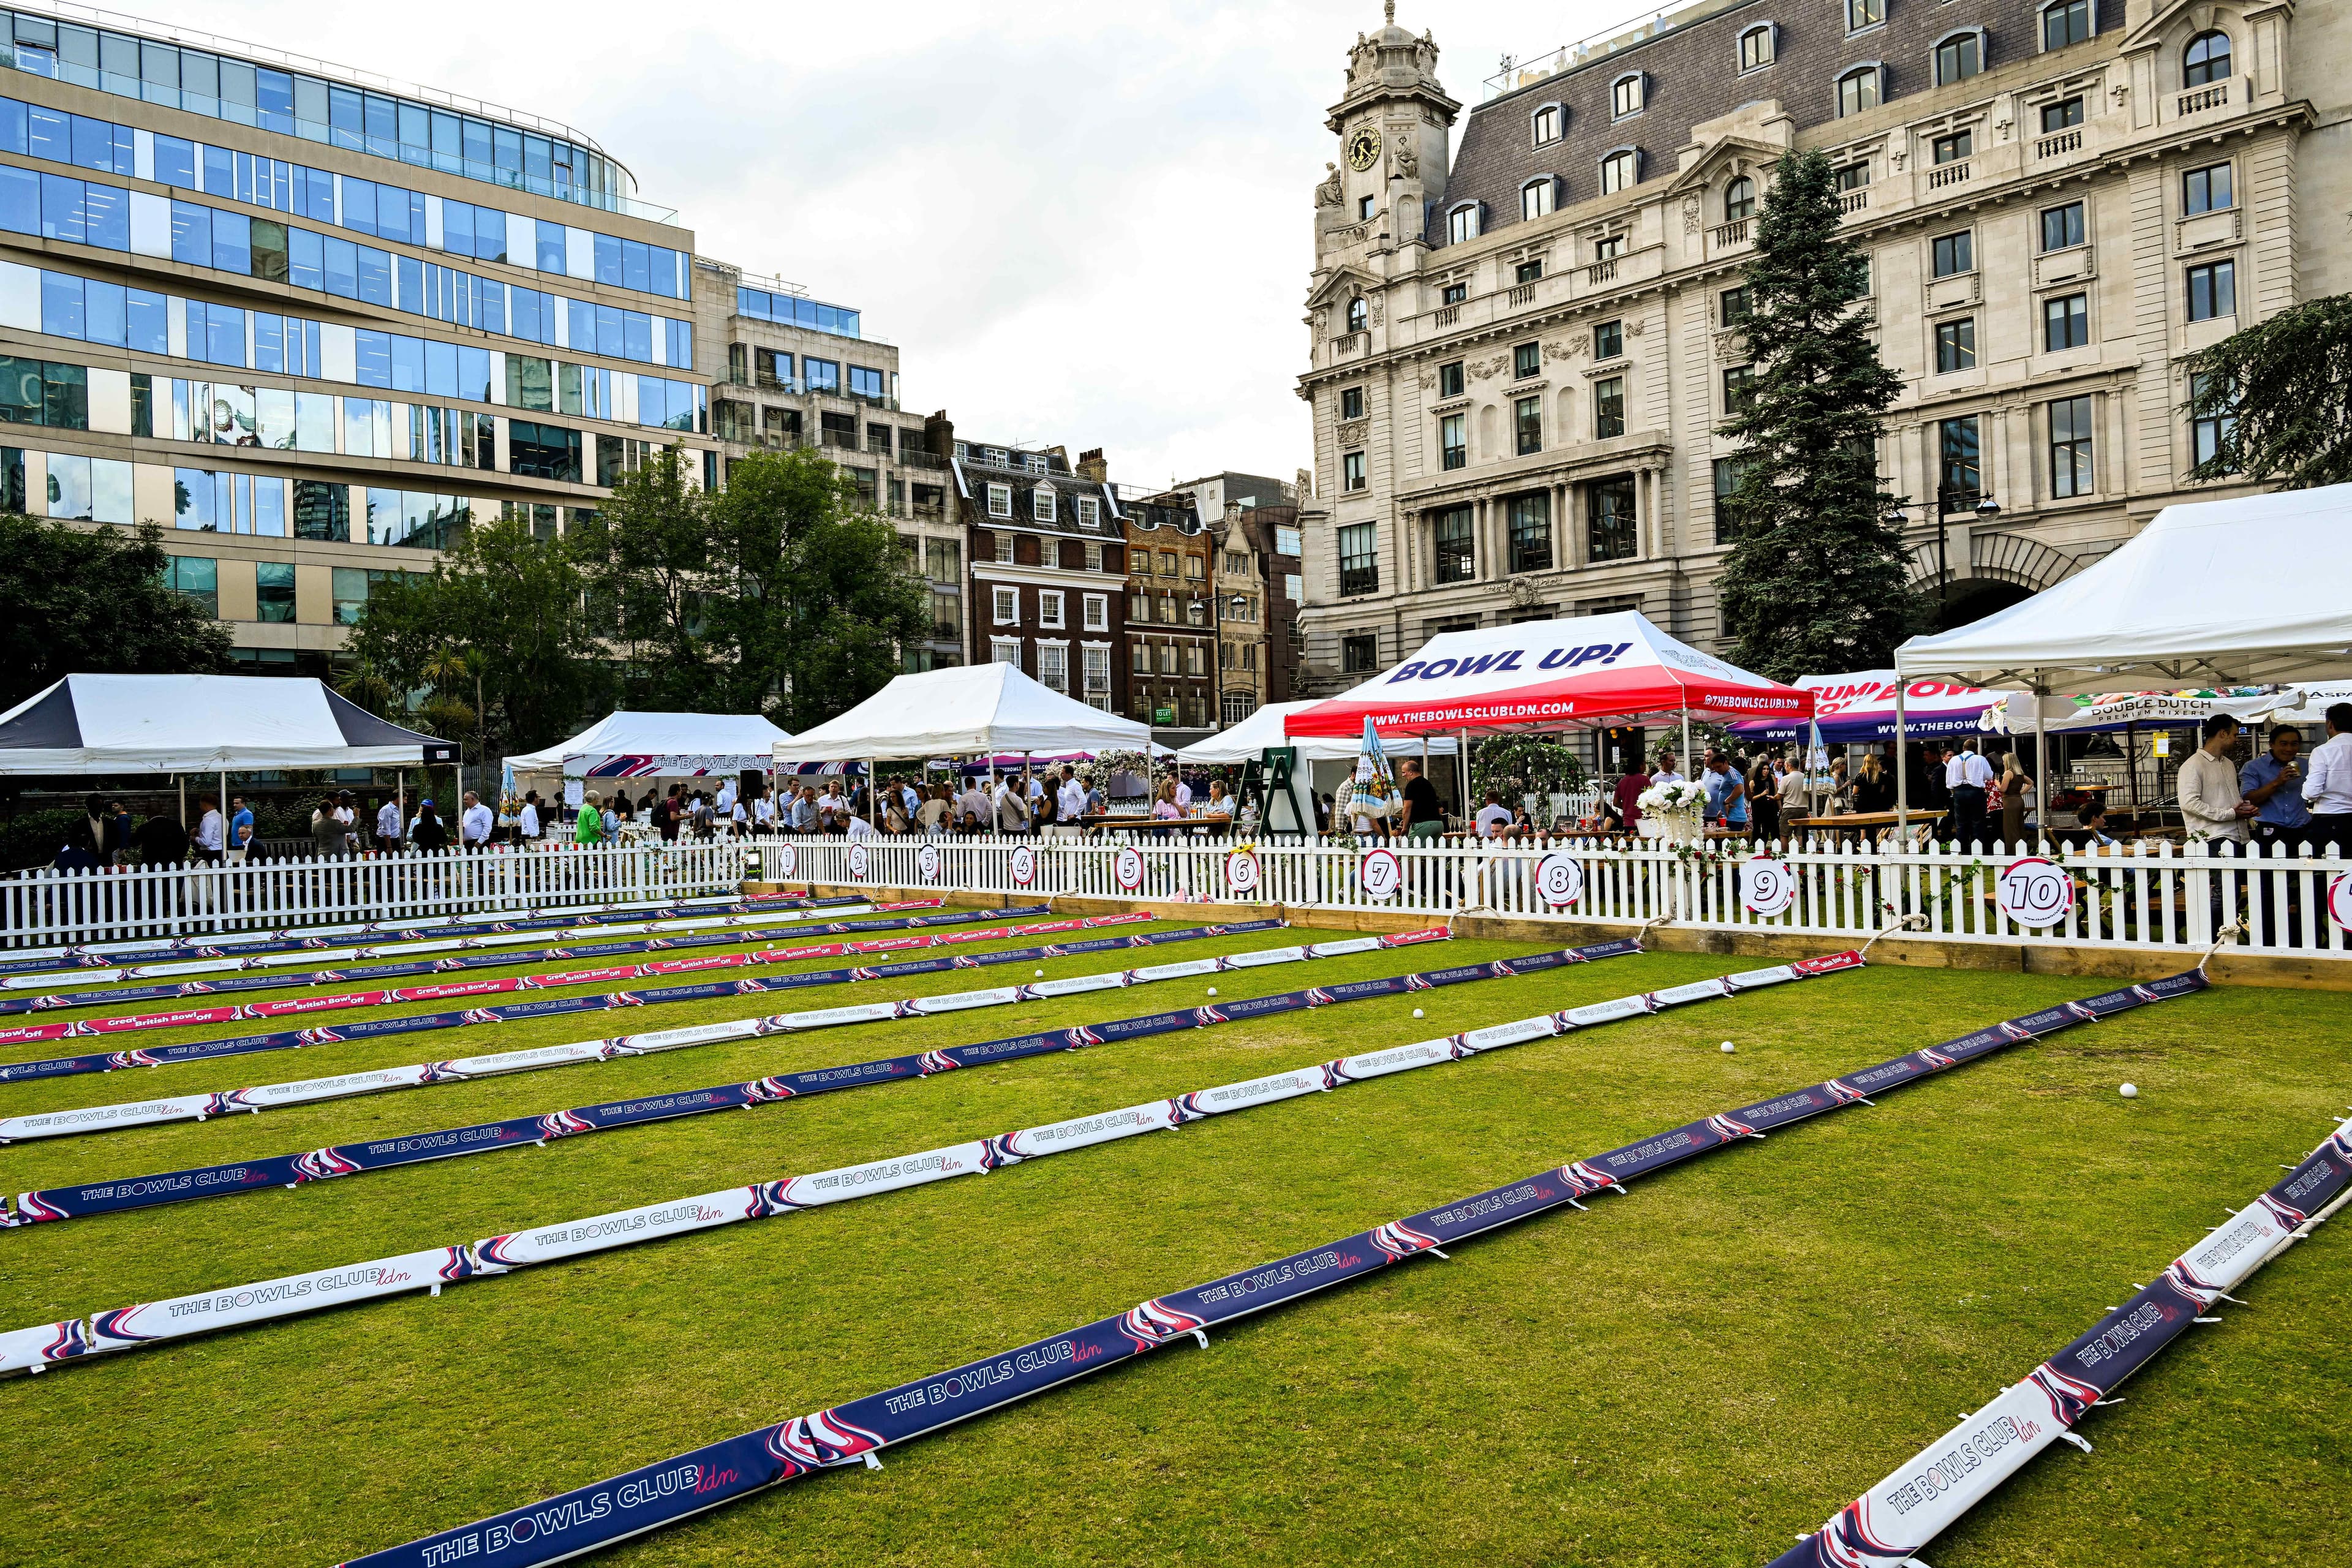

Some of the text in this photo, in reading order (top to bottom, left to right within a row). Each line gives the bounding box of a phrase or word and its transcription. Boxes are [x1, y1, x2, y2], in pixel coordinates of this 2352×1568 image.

[1384, 650, 1525, 685] BOWL
[1537, 641, 1633, 671] UP!
[1704, 695, 1799, 709] @THEBOWLSCLUBLDN
[2092, 699, 2212, 715] DOUBLE DUTCH
[2098, 710, 2150, 722] PREMIUM
[653, 756, 678, 767] THE
[681, 756, 737, 769] BOWLS
[785, 851, 790, 867] 1
[854, 852, 862, 870] 2
[925, 853, 934, 871] 3
[1017, 856, 1029, 875] 4
[1123, 858, 1134, 878] 5
[1235, 859, 1249, 881] 6
[1373, 862, 1389, 886] 7
[1549, 866, 1569, 893] 8
[1754, 870, 1778, 901] 9
[2010, 876, 2060, 910] 10
[271, 995, 364, 1010] Great British Bowl Off
[108, 1011, 212, 1027] Great British Bowl Off
[368, 1020, 407, 1030] BOWLS
[409, 1017, 437, 1025] CLUB
[189, 1041, 235, 1053] BOWLS
[236, 1037, 268, 1047] CLUB
[963, 1047, 979, 1055] THE
[979, 1042, 1017, 1055] BOWLS
[1017, 1038, 1044, 1049] CLUB
[1355, 1047, 1441, 1068] THE BOWLS CLUB ldn
[268, 1073, 403, 1095] THE BOWLS CLUB ldn
[799, 1074, 818, 1083] THE
[818, 1068, 862, 1081] BOWLS
[862, 1063, 892, 1074] CLUB
[1211, 1077, 1311, 1101] THE BOWLS CLUB ldn
[23, 1104, 185, 1128] THE BOWLS CLUB ldn
[600, 1106, 623, 1115] THE
[624, 1098, 674, 1114] BOWLS
[676, 1093, 711, 1106] CLUB
[1033, 1112, 1154, 1142] THE BOWLS CLUB ldn
[368, 1127, 521, 1155] THE BOWLS CLUB ldn
[1607, 1133, 1691, 1166] THE BOWLS CLUB
[81, 1168, 270, 1200] THE BOWLS CLUB ldn
[813, 1156, 963, 1190] THE BOWLS CLUB ldn
[1430, 1211, 1454, 1226] THE
[1453, 1196, 1504, 1221] BOWLS
[1502, 1185, 1537, 1205] CLUB
[535, 1205, 724, 1245] THE BOWLS CLUB ldn
[2196, 1248, 2218, 1269] THE
[2213, 1232, 2244, 1264] BOWLS
[2238, 1221, 2261, 1248] CLUB
[1198, 1252, 1361, 1304] THE BOWLS CLUB ldn
[168, 1268, 410, 1317] THE BOWLS CLUB ldn
[2076, 1344, 2101, 1368] THE
[2095, 1319, 2138, 1360] BOWLS
[2132, 1302, 2163, 1338] CLUB
[885, 1340, 1101, 1414] THE BOWLS CLUB ldn
[1887, 1416, 2040, 1515] THE BOWLS CLUB ldn
[422, 1464, 737, 1567] THE BOWLS CLUB ldn
